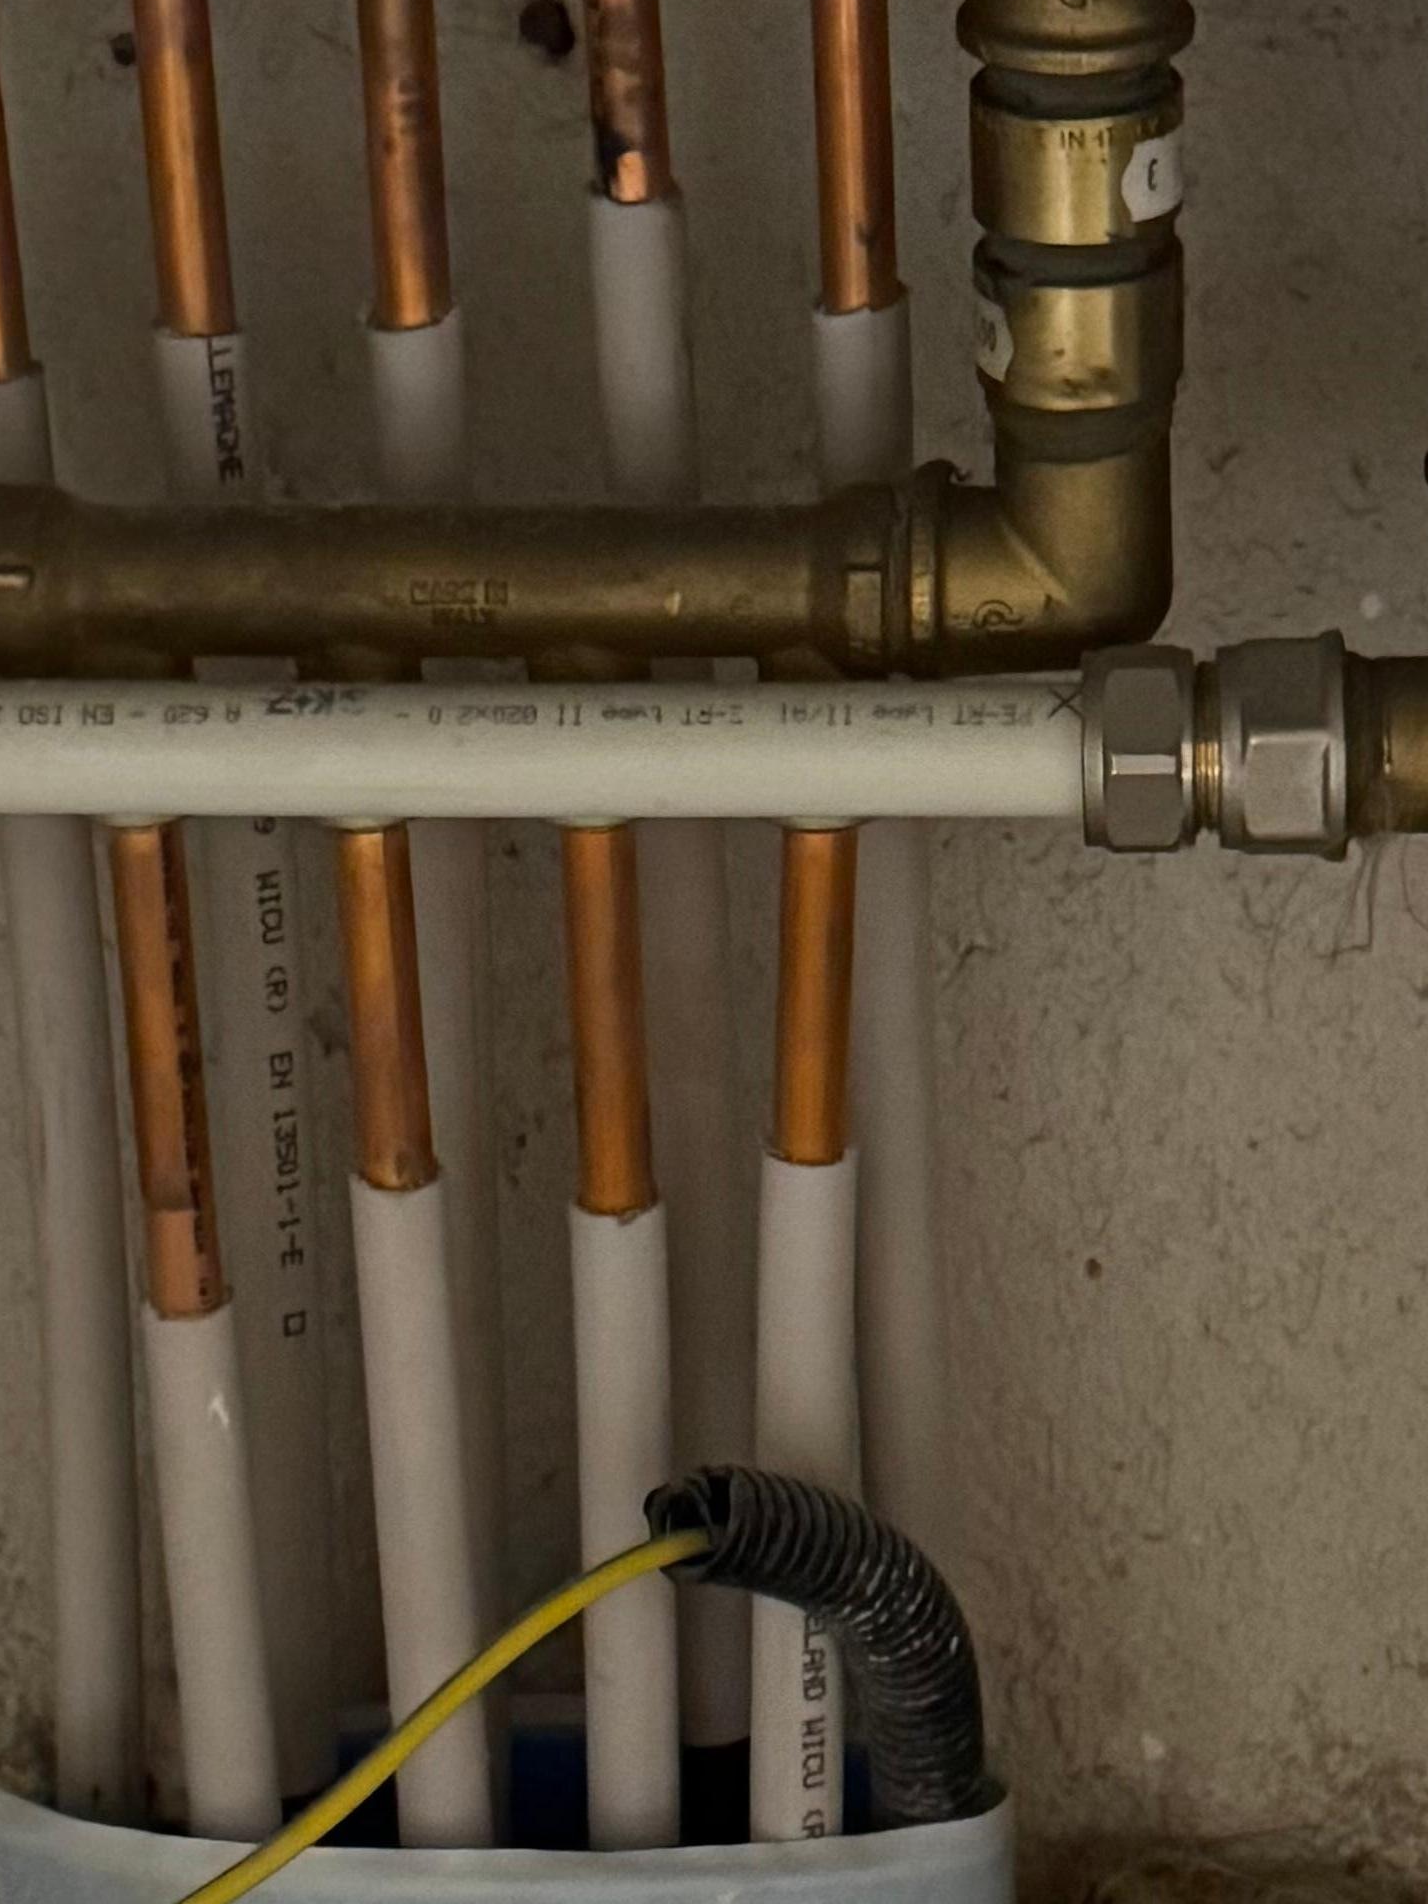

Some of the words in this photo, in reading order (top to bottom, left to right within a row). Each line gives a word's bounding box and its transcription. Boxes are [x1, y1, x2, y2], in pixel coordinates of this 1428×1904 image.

[17, 704, 64, 726] ISO
[82, 703, 115, 726] EN
[163, 704, 210, 725] 620
[255, 871, 285, 946] WICU
[265, 965, 290, 1015] (R)
[268, 1050, 296, 1089] EN
[271, 1109, 304, 1269] 13501-1-E
[801, 1714, 827, 1791] WICU
